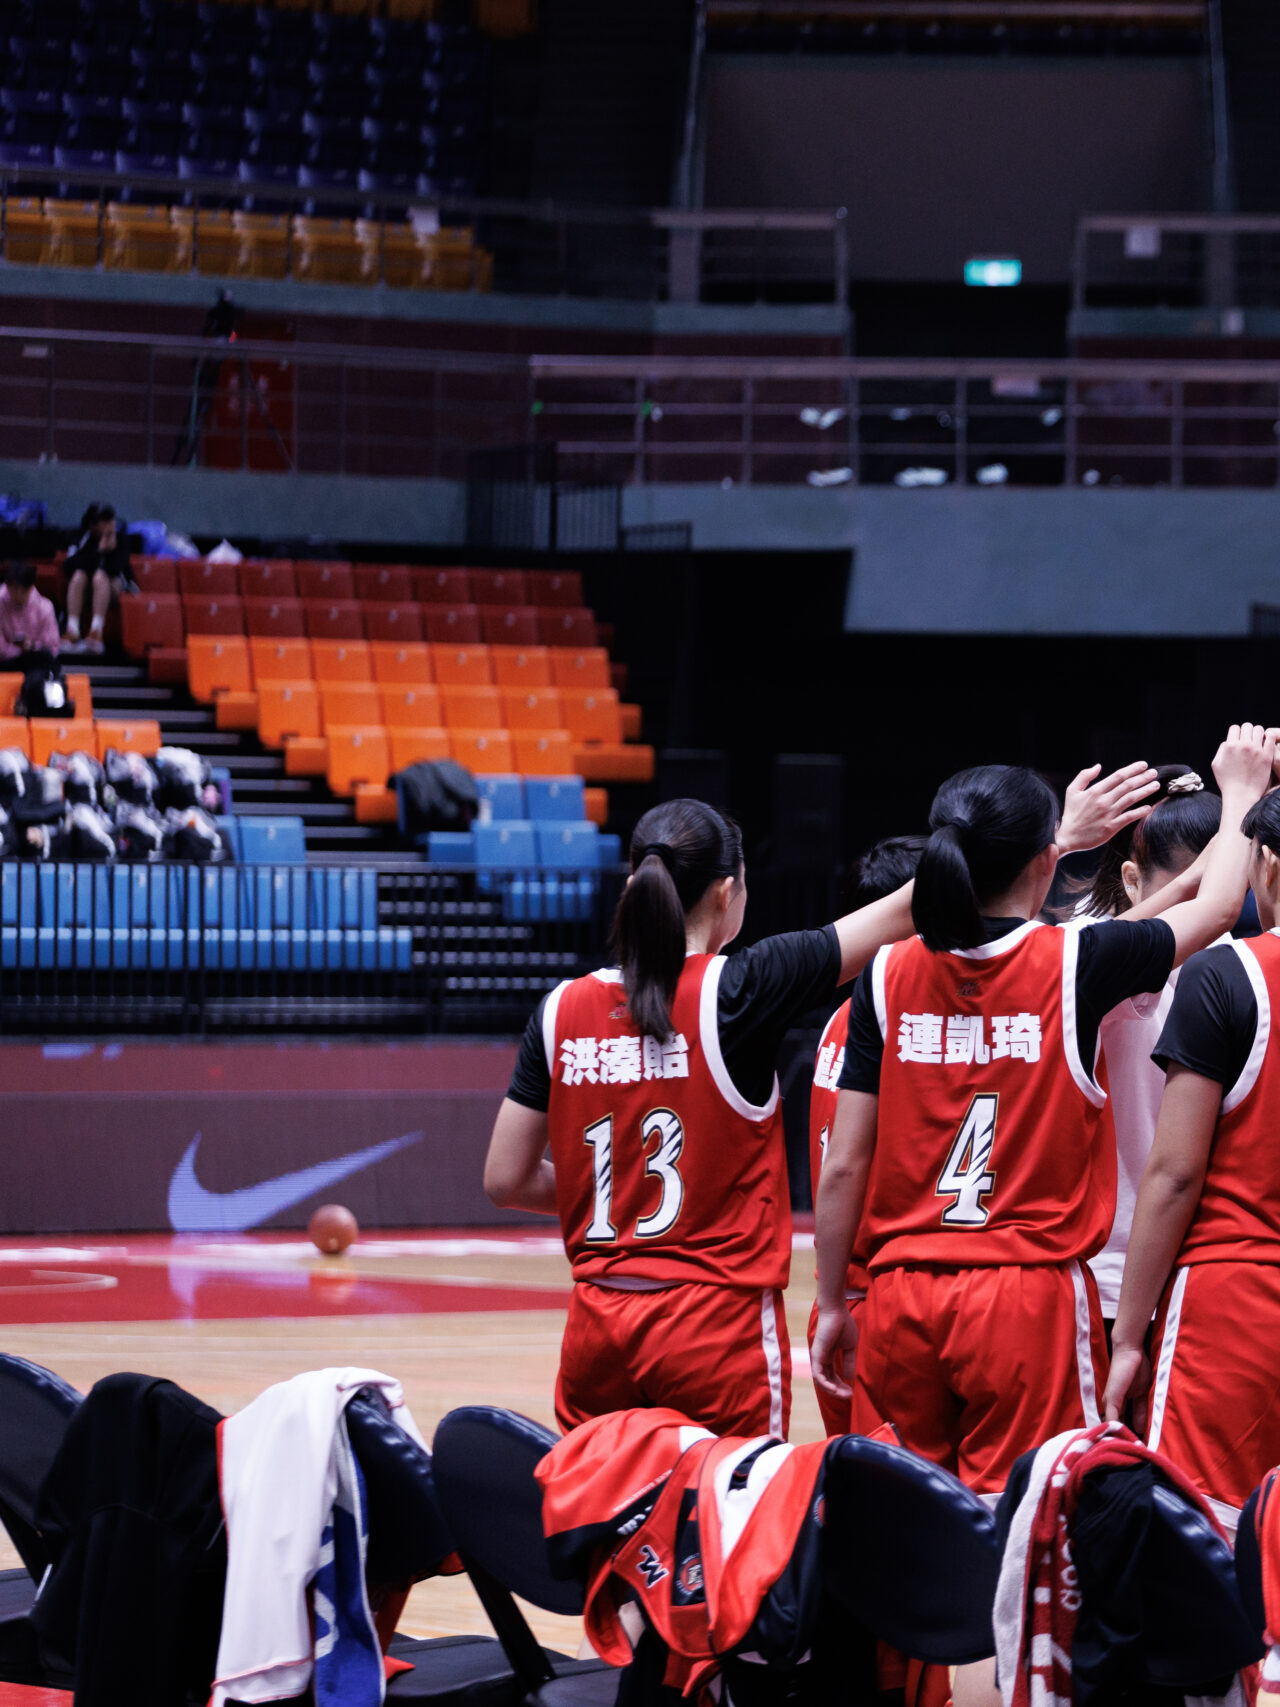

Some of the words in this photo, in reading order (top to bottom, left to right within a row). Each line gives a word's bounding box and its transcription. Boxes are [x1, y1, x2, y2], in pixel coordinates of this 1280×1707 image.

[897, 1012, 1043, 1065] 連凱琦
[584, 1106, 684, 1244] 13
[935, 1092, 1000, 1226] 4
